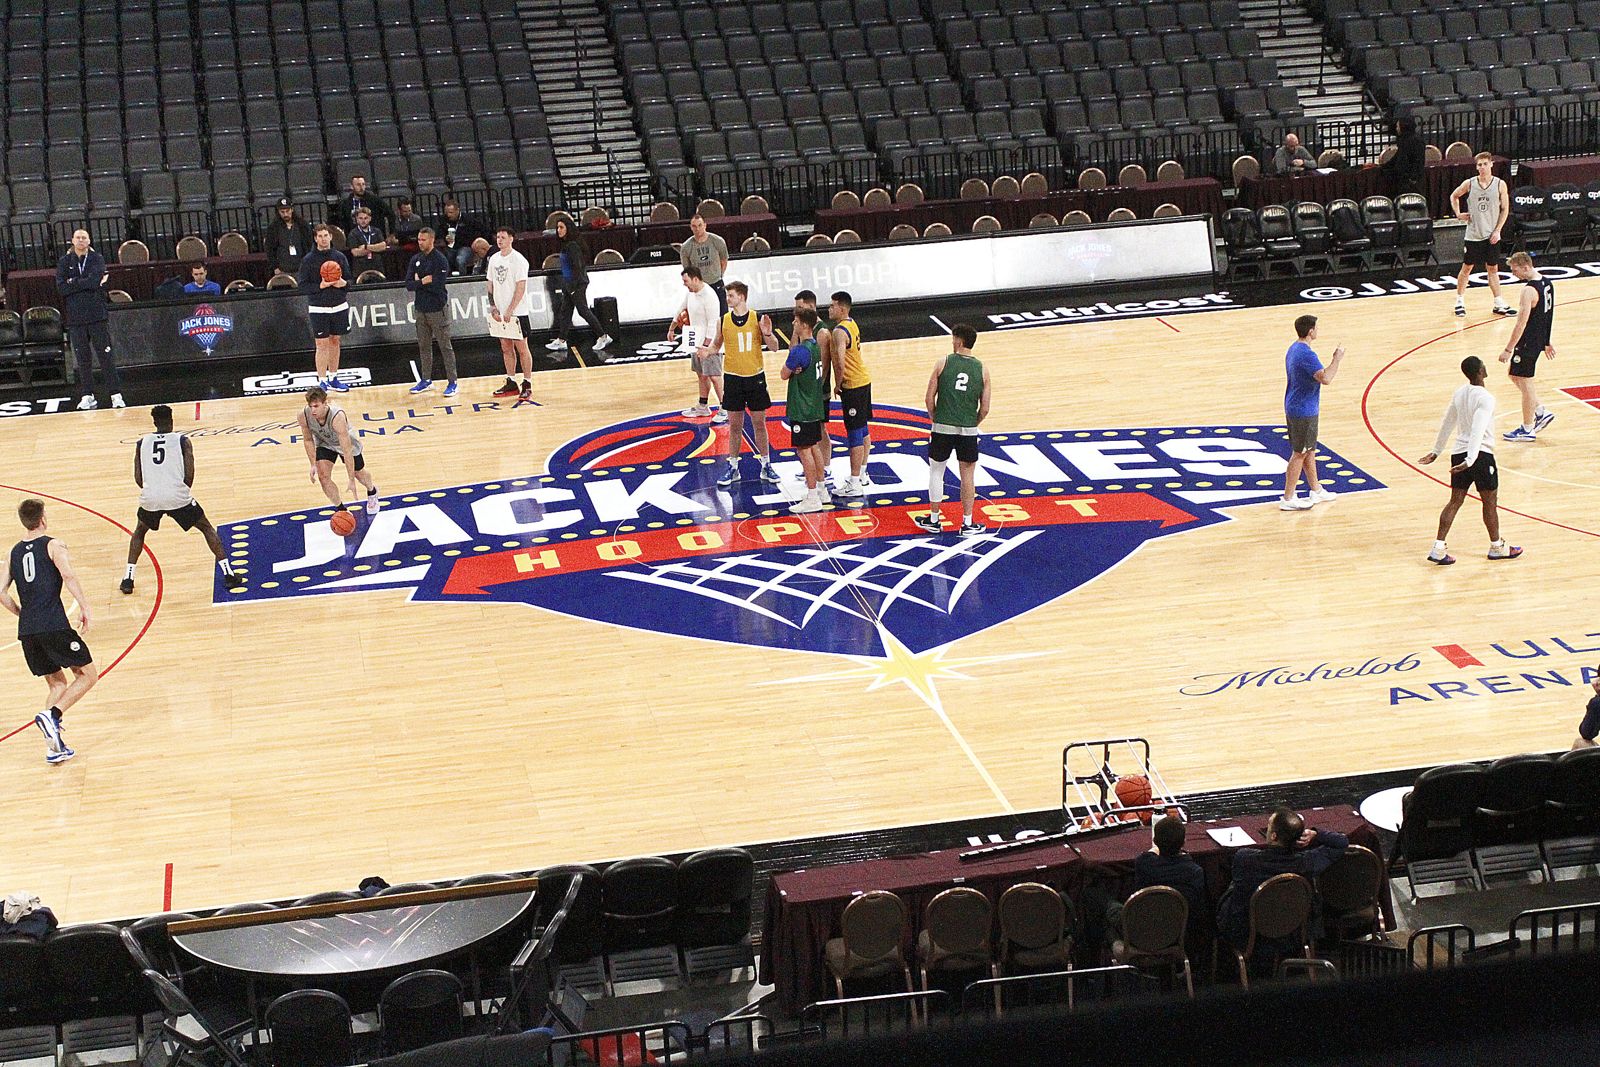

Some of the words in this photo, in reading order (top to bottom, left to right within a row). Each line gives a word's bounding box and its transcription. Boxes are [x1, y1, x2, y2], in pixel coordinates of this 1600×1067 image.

[987, 291, 1235, 324] nutricost
[181, 317, 202, 331] JACK
[203, 316, 230, 327] JONES
[688, 331, 696, 347] BYU
[737, 331, 752, 353] 11
[955, 372, 969, 392] 2
[362, 399, 544, 422] ULTRA
[152, 440, 166, 465] 5
[272, 470, 711, 573] JACK
[753, 436, 1289, 506] JONES
[513, 497, 1099, 573] HOOPFEST
[22, 551, 36, 583] 0
[1179, 651, 1422, 696] Michelob
